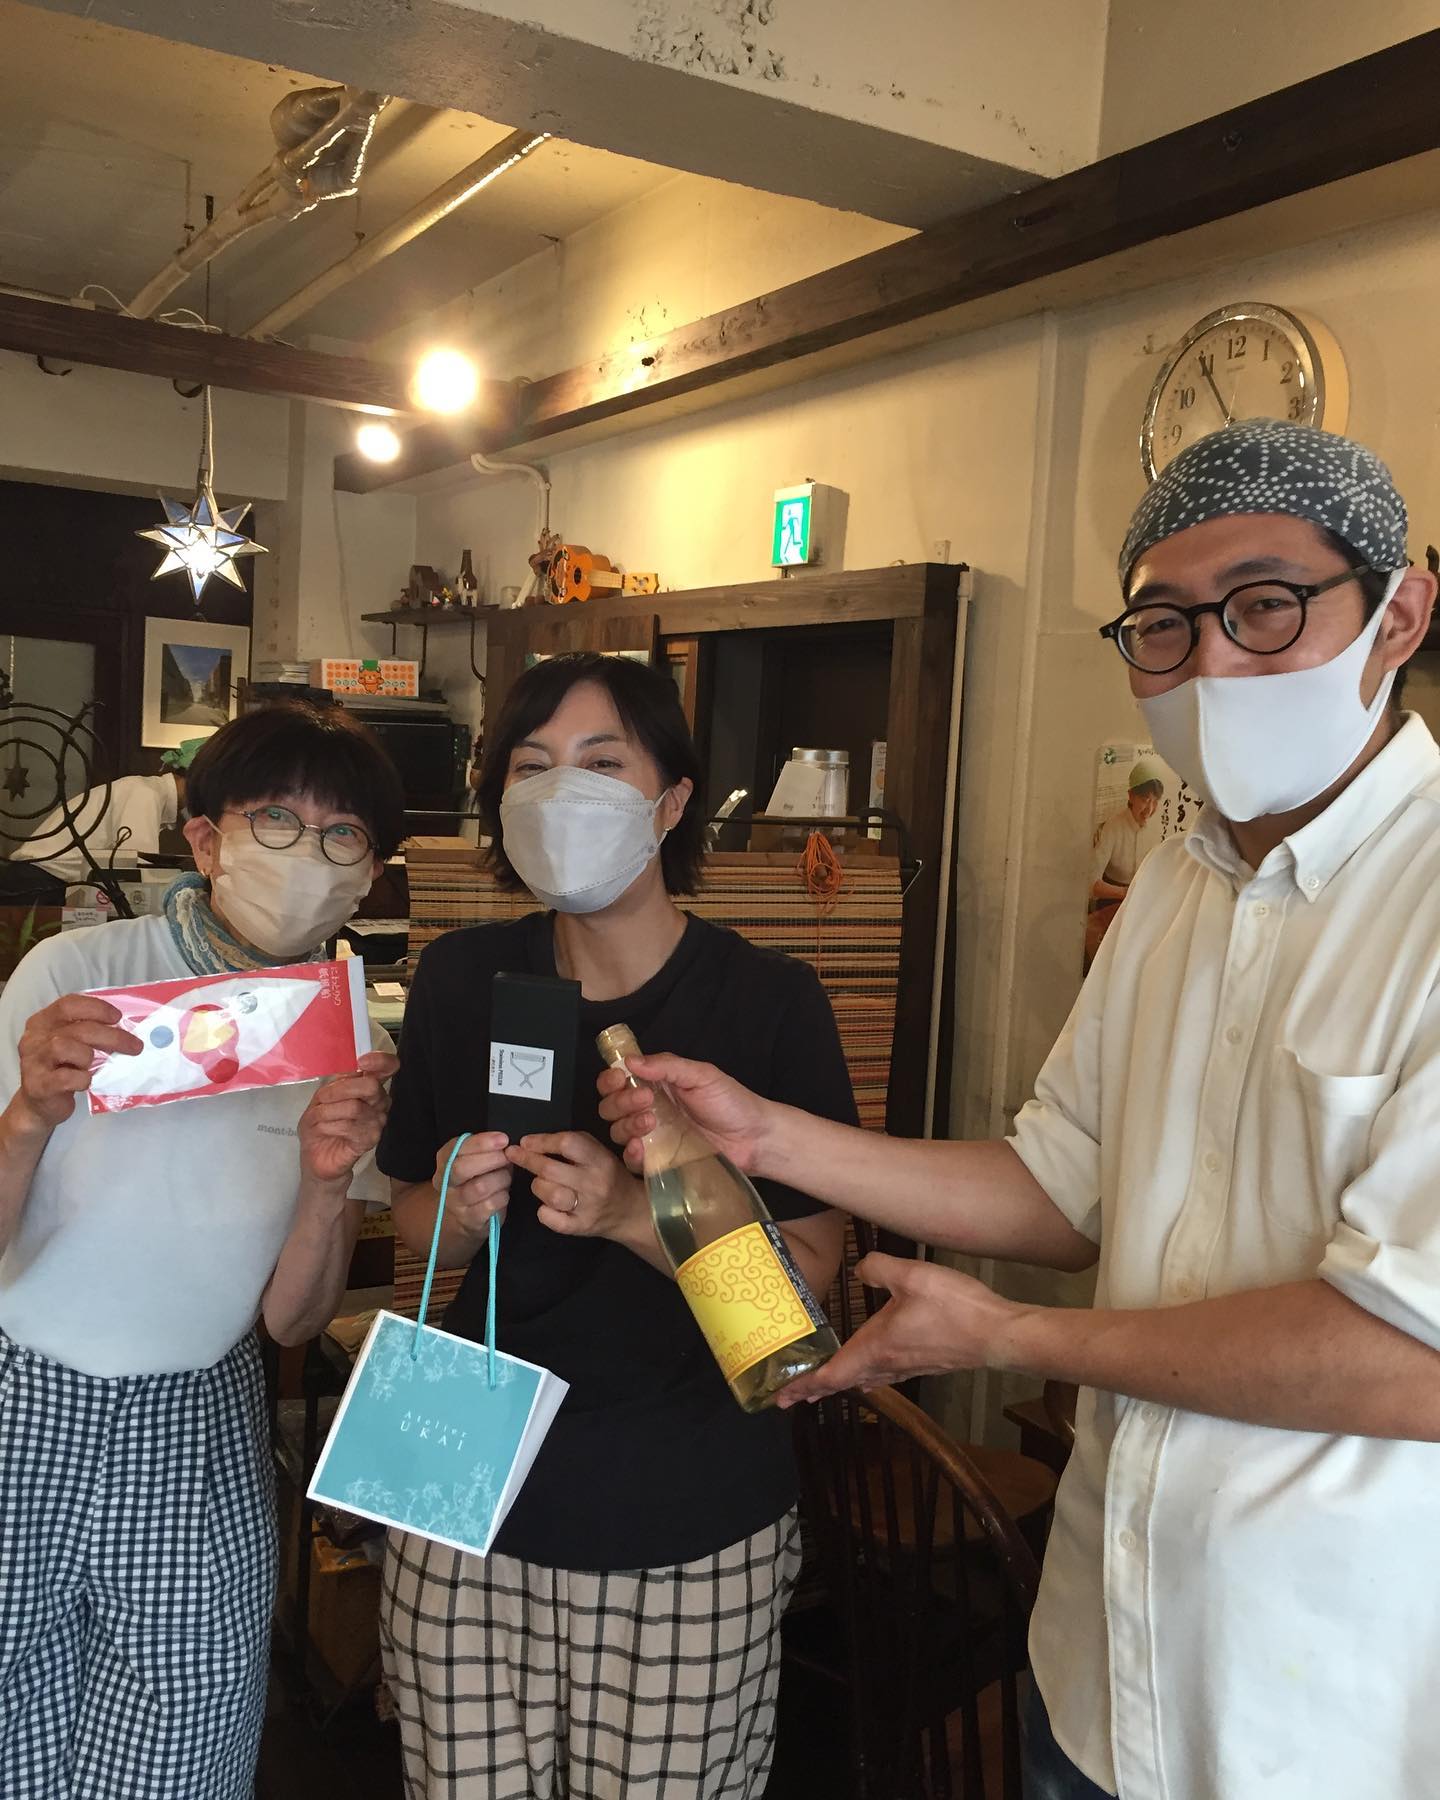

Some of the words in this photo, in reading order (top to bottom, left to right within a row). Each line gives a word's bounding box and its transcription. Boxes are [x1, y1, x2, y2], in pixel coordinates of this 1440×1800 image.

[1226, 335, 1247, 360] 12
[1262, 339, 1270, 361] 1
[1280, 361, 1294, 384] 2
[1179, 386, 1196, 410] 10
[1288, 397, 1301, 420] 3
[1171, 424, 1183, 446] 9
[400, 1420, 463, 1451] UKAI
[403, 1410, 468, 1438] Atelier
